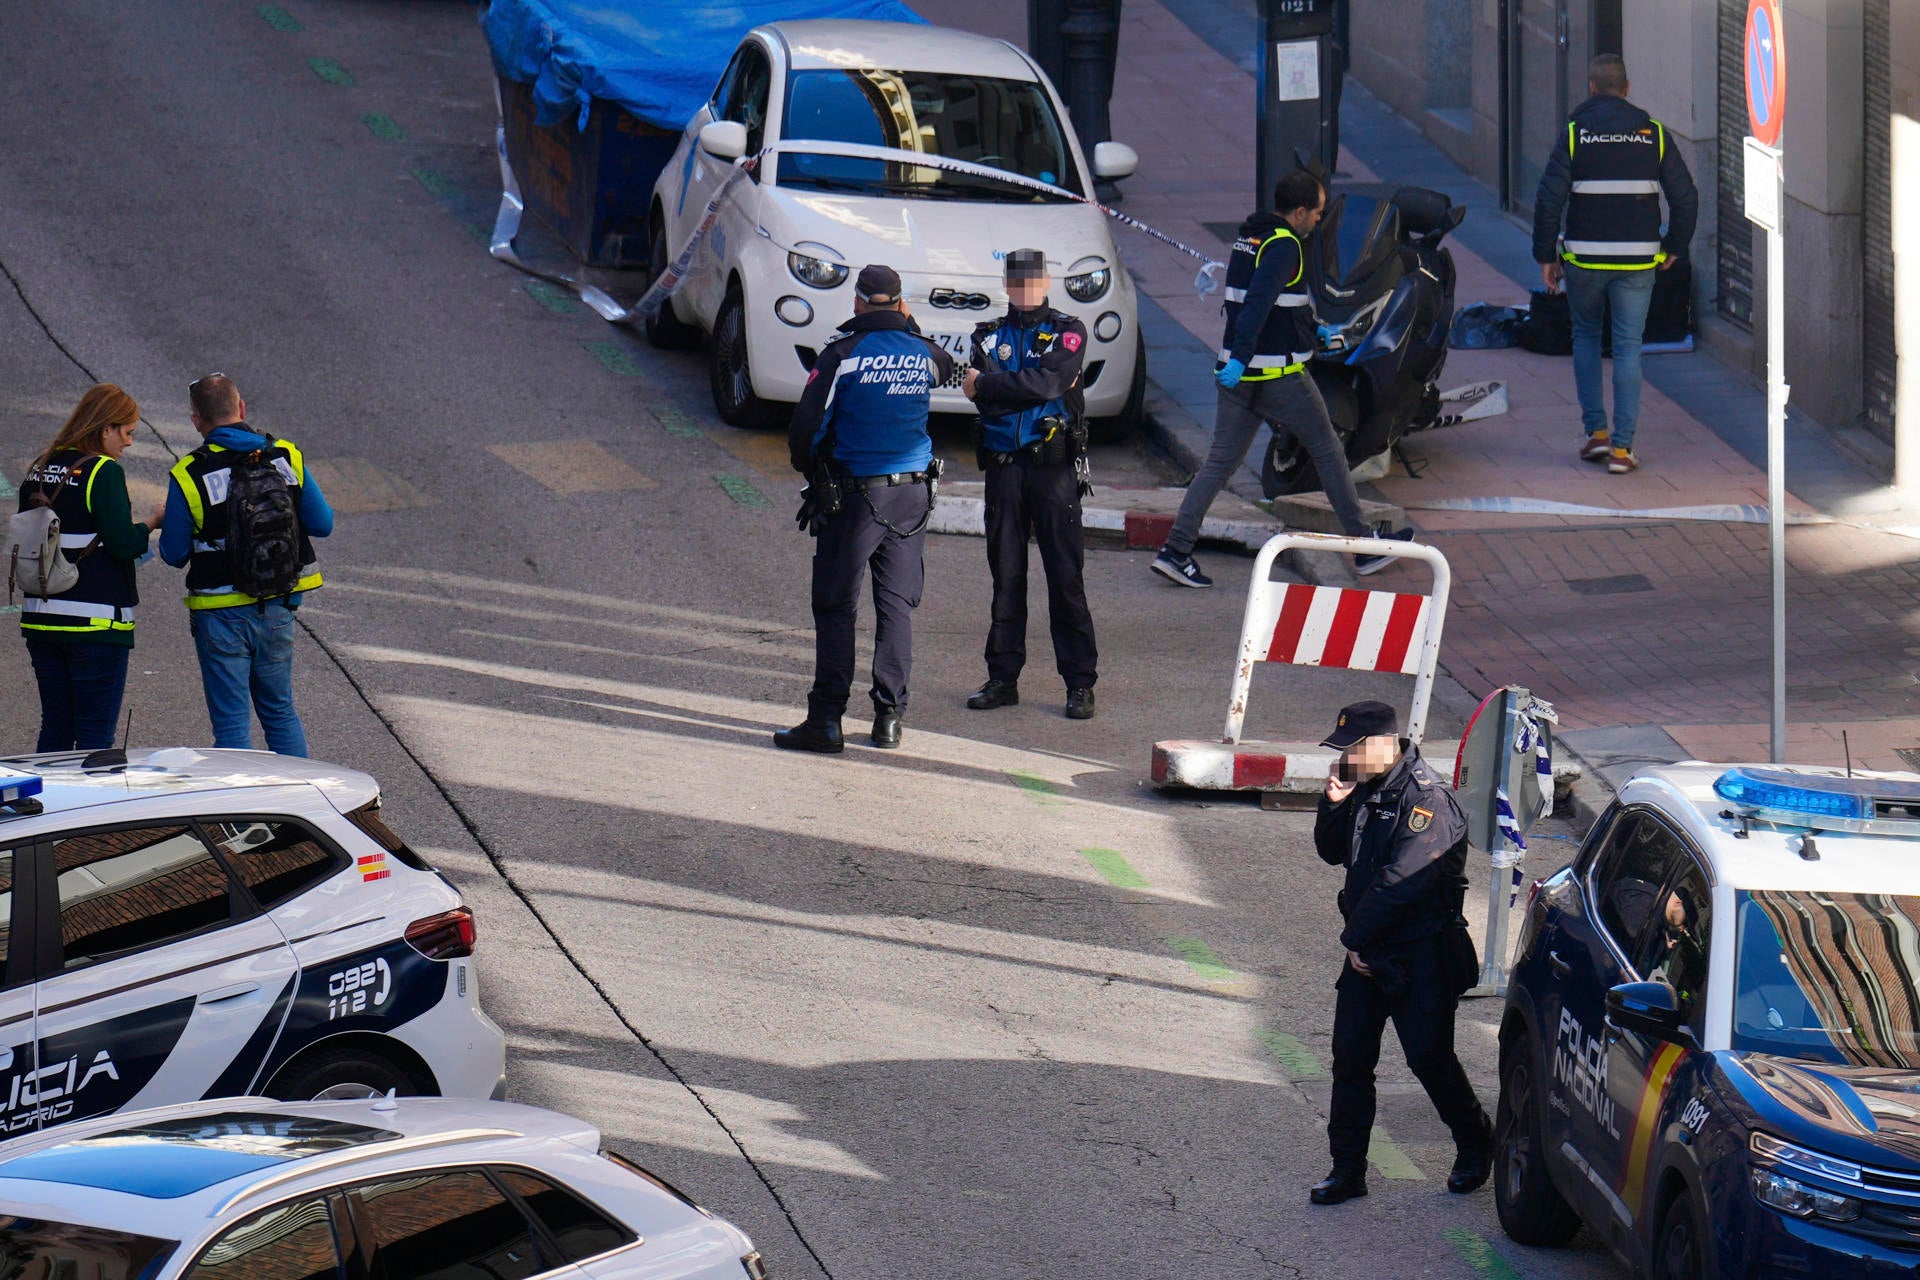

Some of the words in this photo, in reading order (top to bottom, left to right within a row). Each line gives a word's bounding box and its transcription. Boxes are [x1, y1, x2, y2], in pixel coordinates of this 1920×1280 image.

[1580, 134, 1653, 145] NACIONAL
[930, 334, 964, 355] 74
[860, 354, 928, 371] POLICÍA
[329, 962, 376, 997] 092
[328, 989, 367, 1021] 112
[1558, 1006, 1609, 1089] POLICIA
[1553, 1045, 1621, 1141] NACIONAL
[1684, 1100, 1710, 1134] 091
